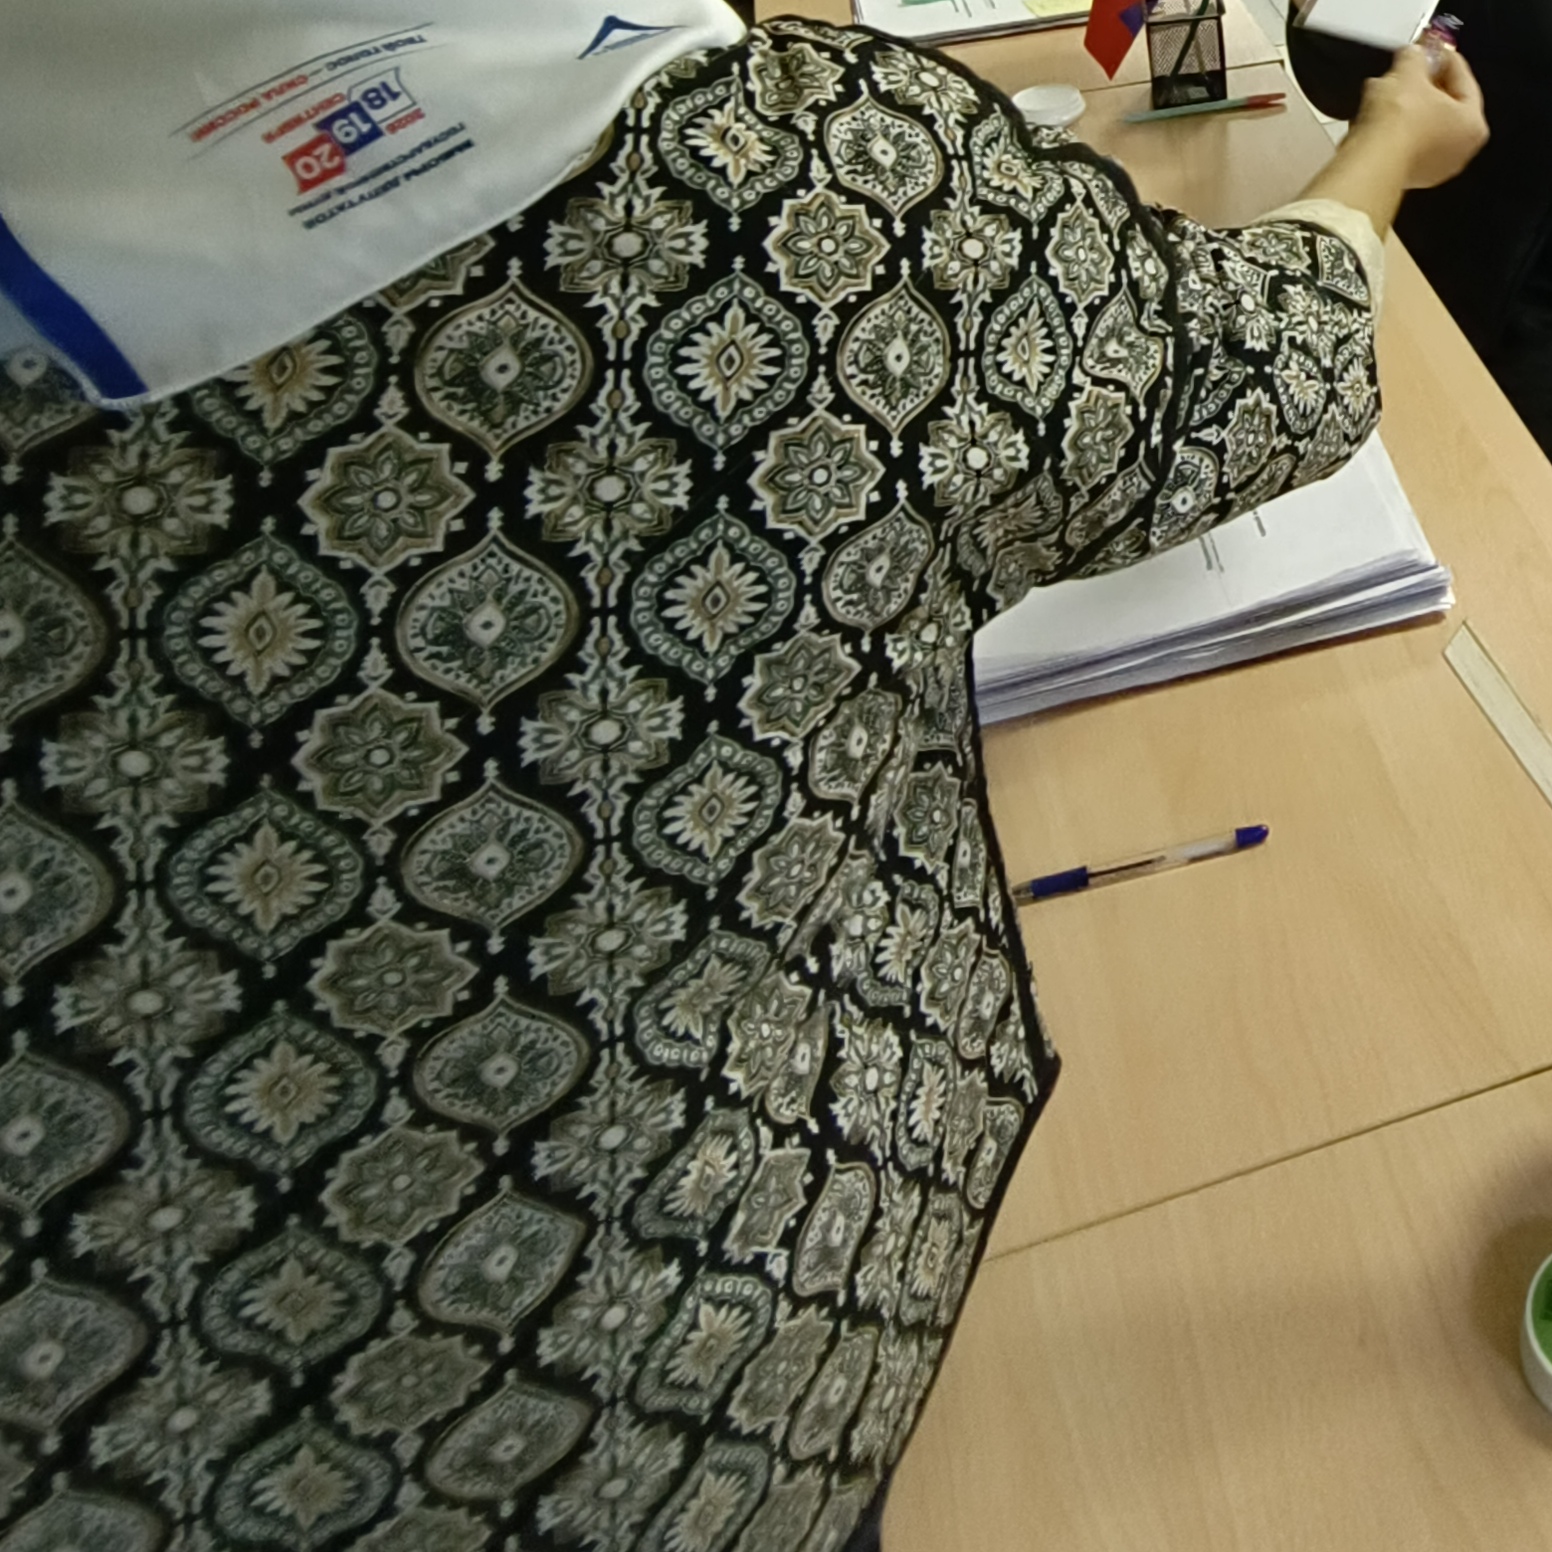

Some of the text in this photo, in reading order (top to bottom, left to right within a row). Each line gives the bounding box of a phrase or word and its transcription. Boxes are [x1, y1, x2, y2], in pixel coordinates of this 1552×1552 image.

[295, 81, 402, 180] 18 19 20
